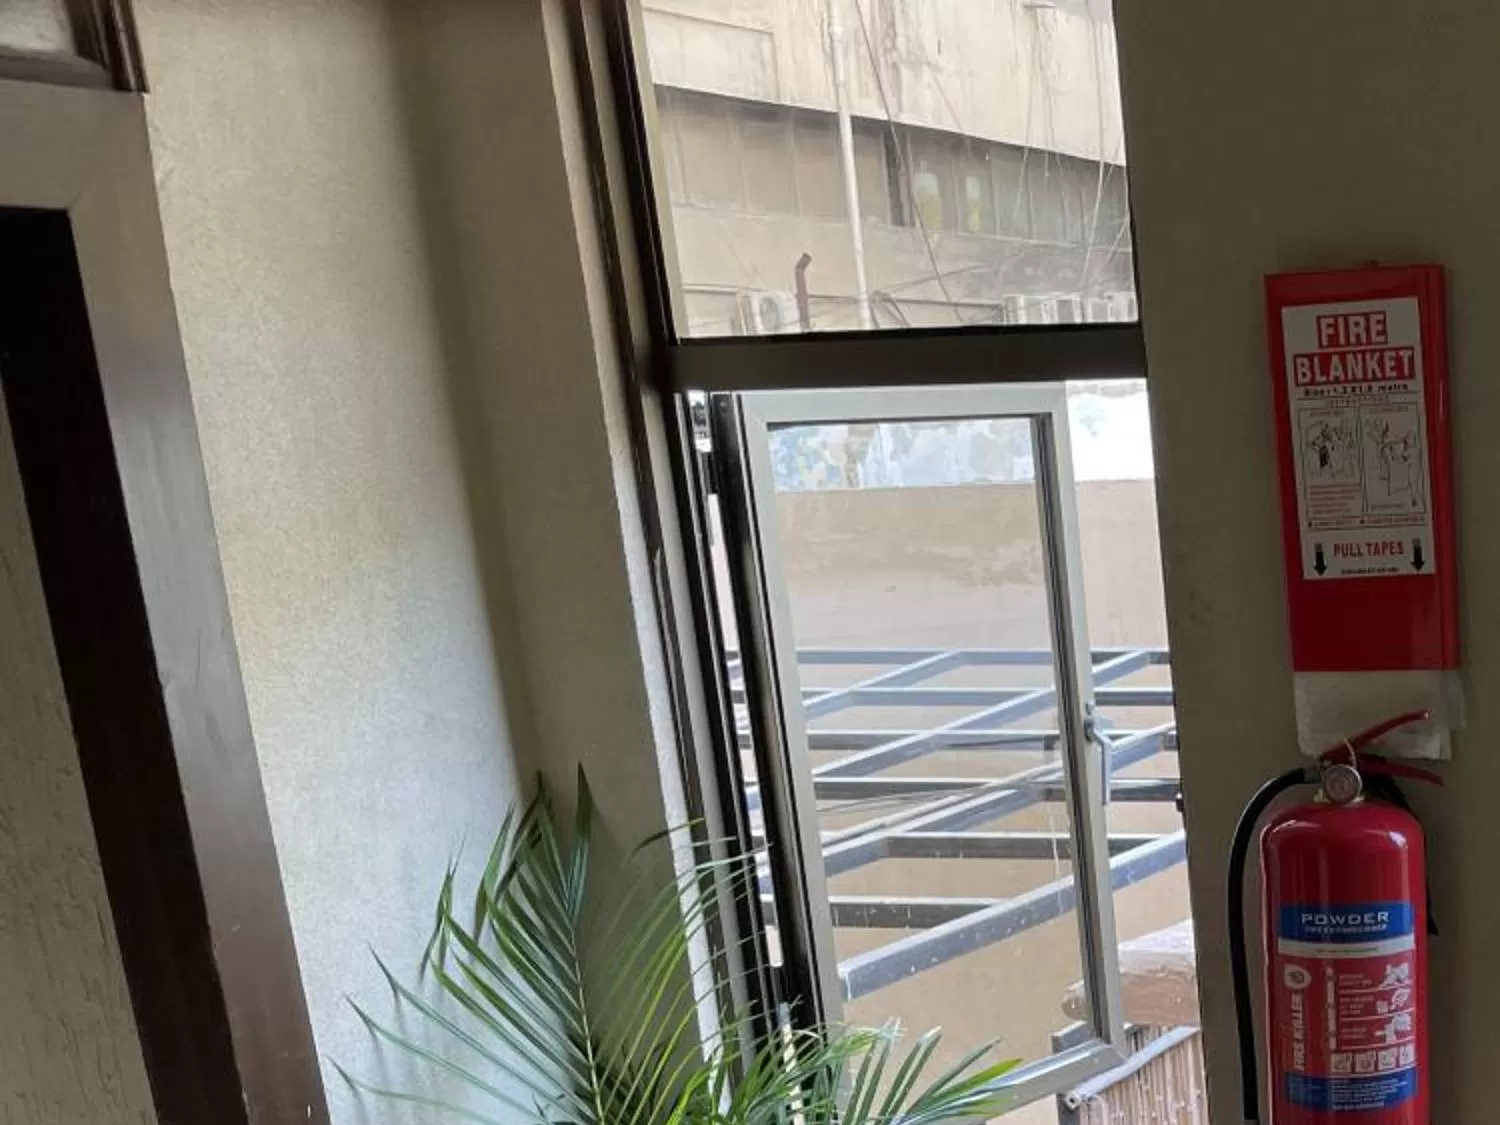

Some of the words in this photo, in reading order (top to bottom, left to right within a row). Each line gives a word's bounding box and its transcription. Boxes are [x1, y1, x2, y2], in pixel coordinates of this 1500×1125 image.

[1318, 313, 1387, 347] FIRE
[1295, 350, 1413, 385] BLANKET
[1333, 543, 1363, 558] PULL
[1366, 540, 1404, 557] TAPES
[1301, 911, 1390, 926] POWDER
